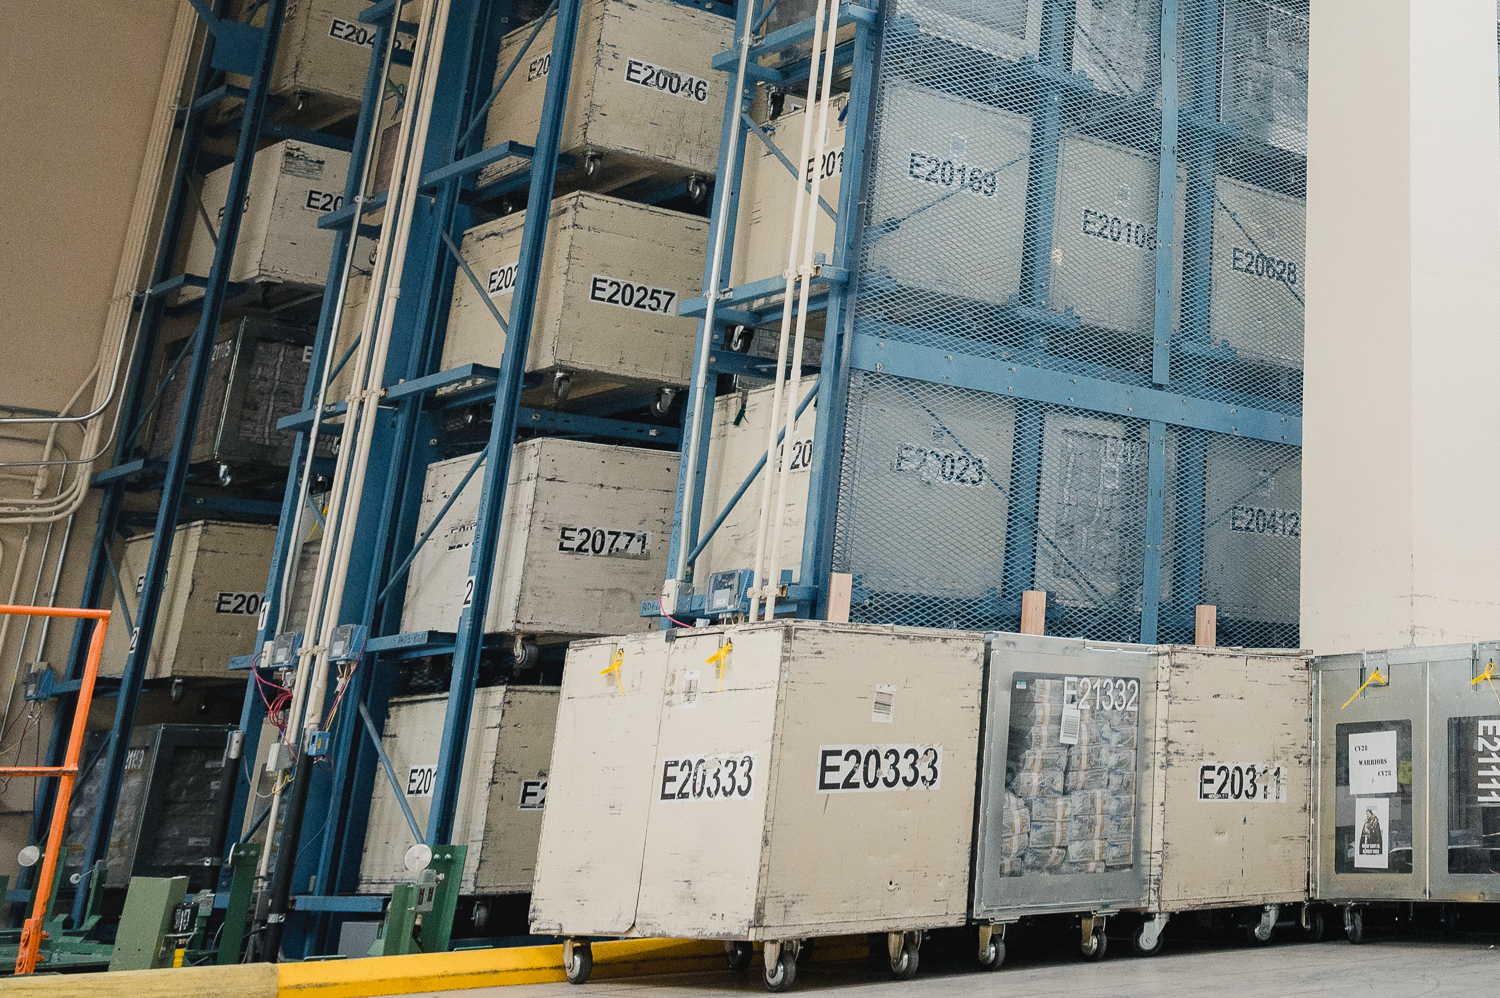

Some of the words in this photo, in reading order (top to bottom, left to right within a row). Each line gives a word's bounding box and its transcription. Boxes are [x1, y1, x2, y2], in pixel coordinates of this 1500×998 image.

[625, 59, 708, 101] E20046
[908, 151, 998, 197] E20169
[1232, 247, 1298, 287] E20628
[590, 277, 676, 314] E20257
[558, 526, 648, 555] E20771
[1231, 506, 1300, 538] E20412
[463, 579, 475, 606] 2
[1064, 676, 1139, 712] E21332
[660, 755, 754, 801] E20333
[818, 747, 939, 791] E20333
[1358, 758, 1388, 766] WARRIORS
